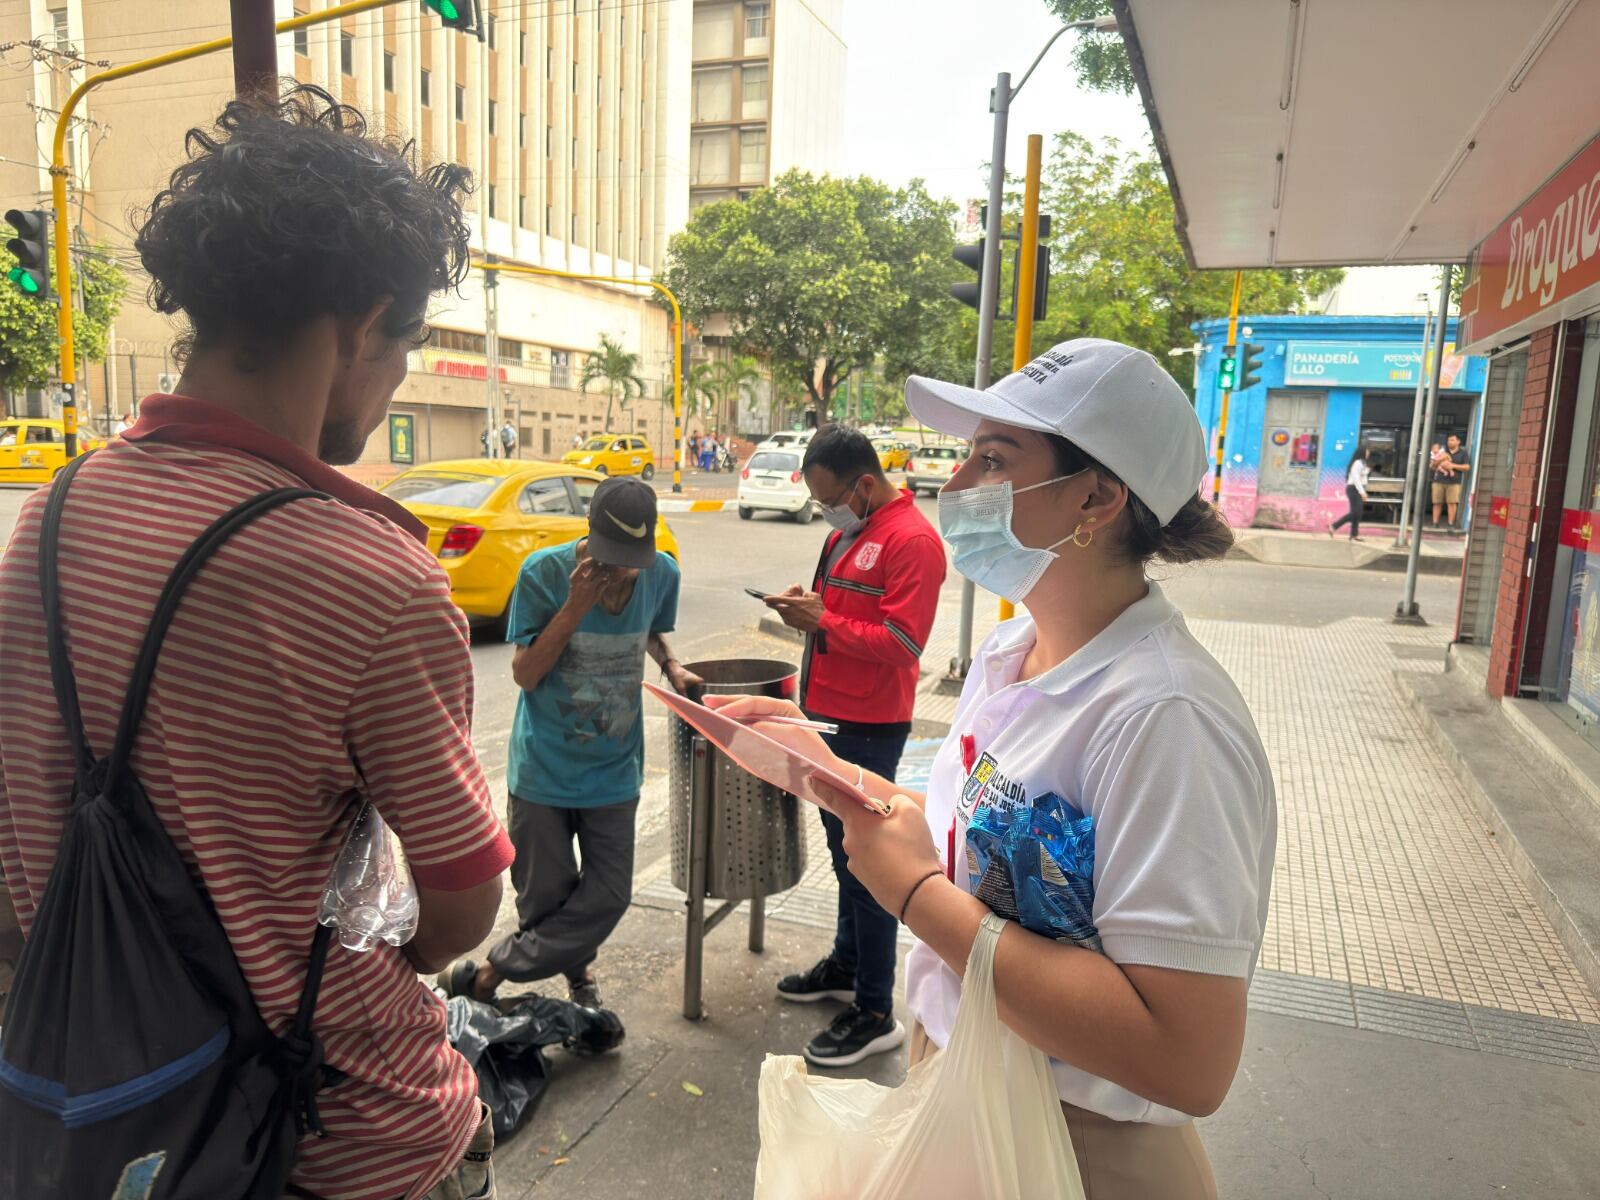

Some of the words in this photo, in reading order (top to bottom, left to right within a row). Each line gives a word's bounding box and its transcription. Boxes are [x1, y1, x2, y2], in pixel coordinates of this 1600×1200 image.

[1293, 351, 1359, 365] PANADERÍA
[1292, 364, 1325, 375] LALO
[988, 769, 1026, 806] ALCALDÍA
[999, 799, 1015, 814] JOSÉ
